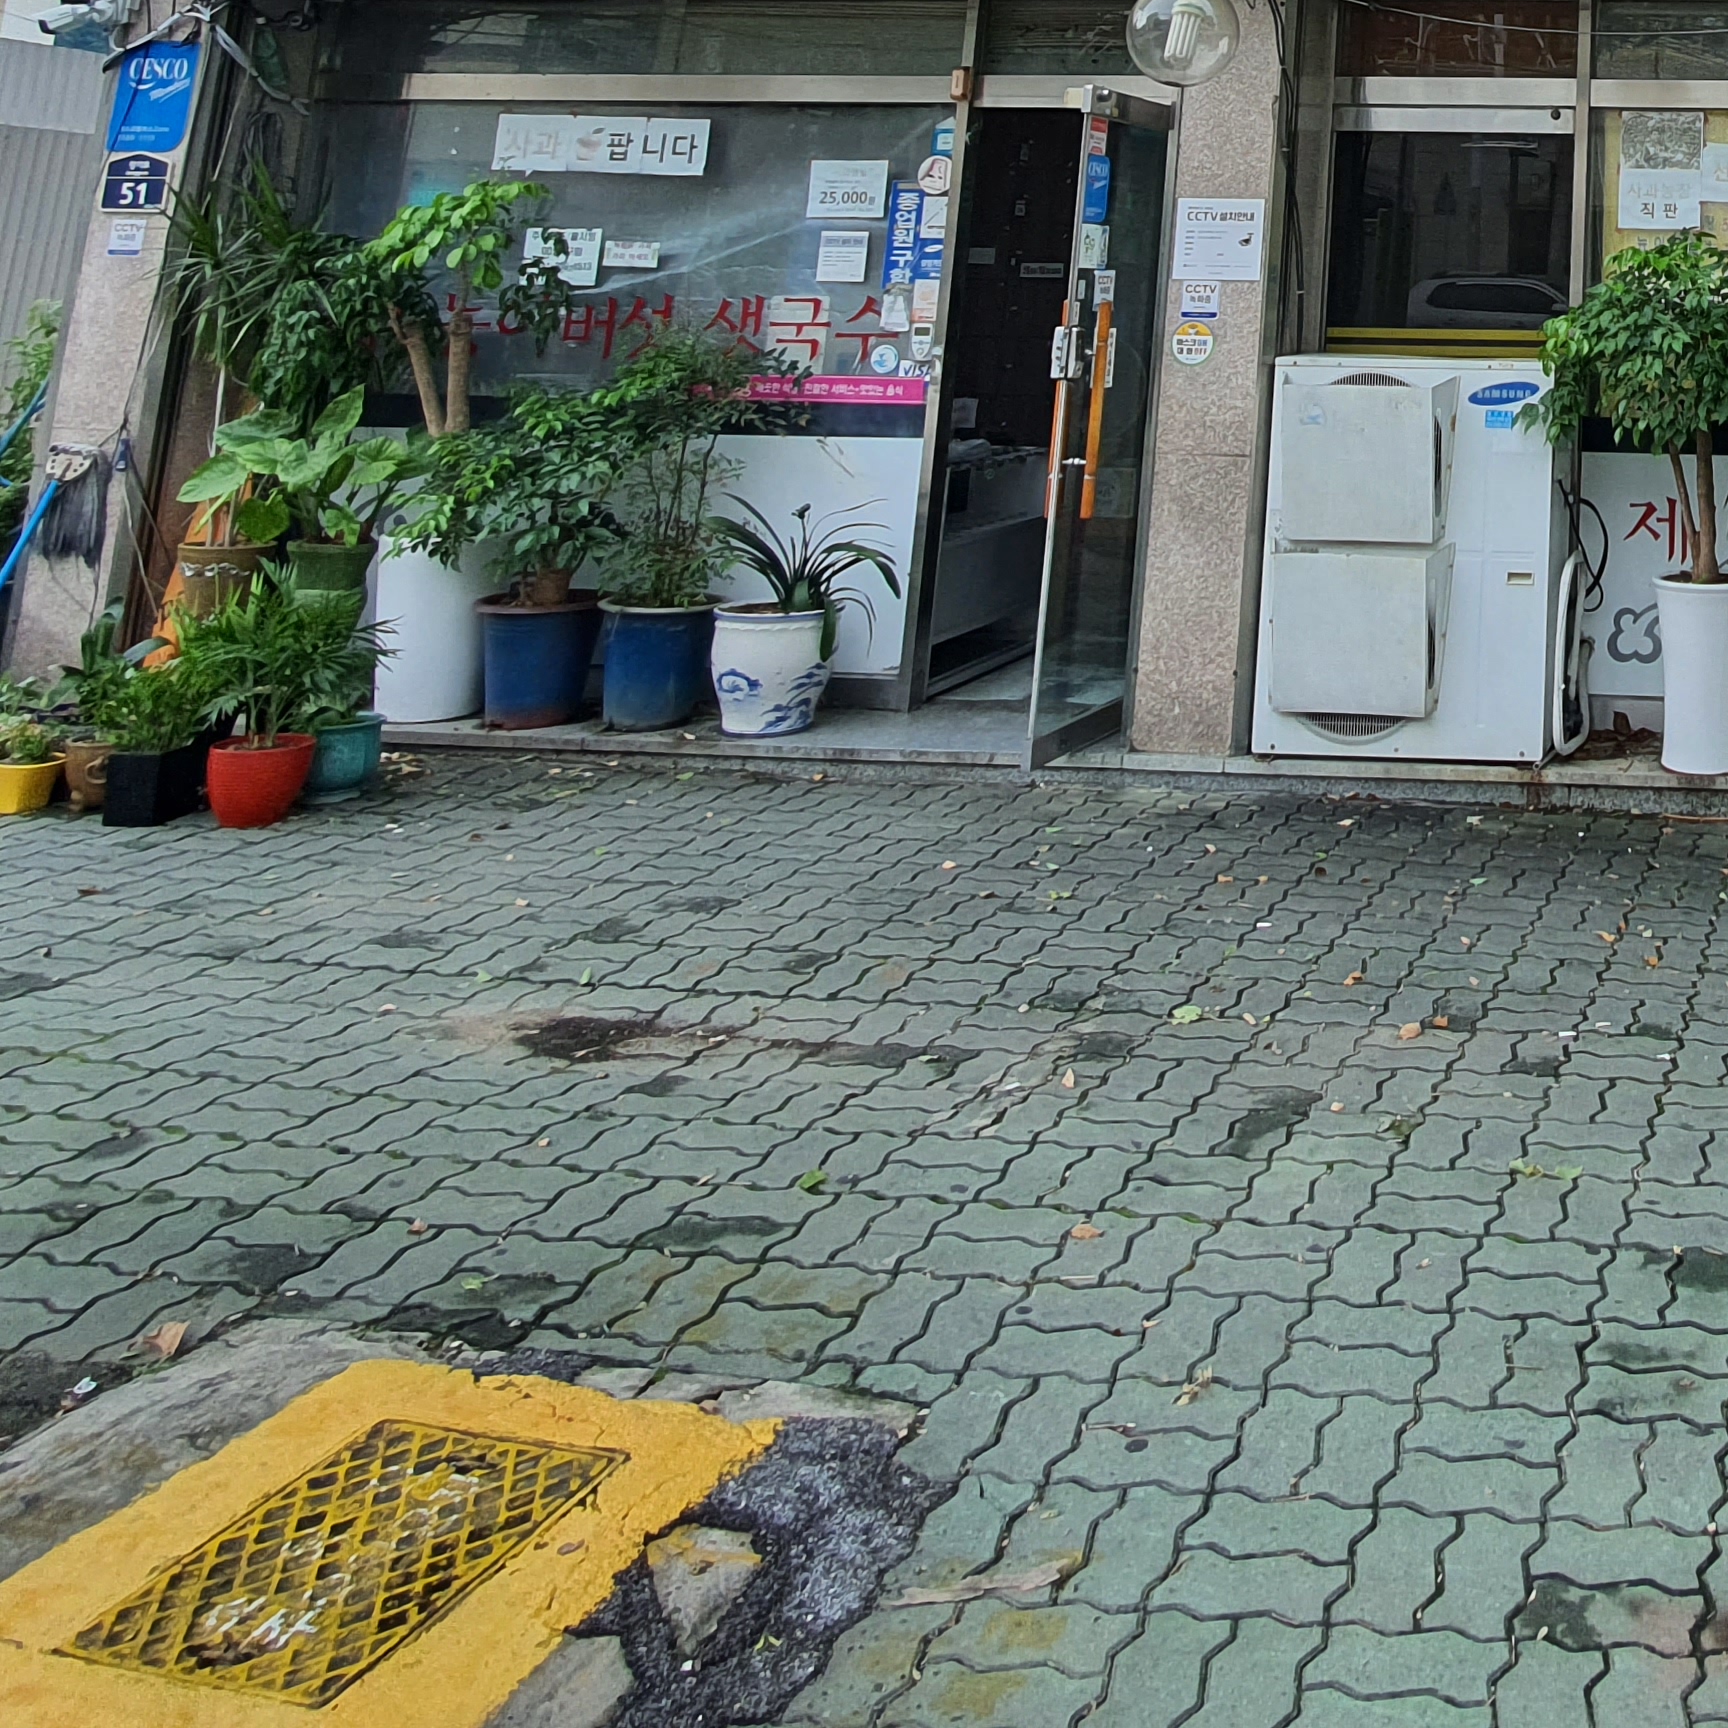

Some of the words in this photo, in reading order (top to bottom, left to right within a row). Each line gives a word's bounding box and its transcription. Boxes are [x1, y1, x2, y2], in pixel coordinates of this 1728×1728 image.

[129, 57, 189, 81] CESCO
[606, 132, 699, 164] 팝니다
[118, 182, 148, 205] 51
[1187, 211, 1218, 222] CCTV
[1219, 211, 1256, 223] 설치안내
[1185, 284, 1217, 294] CCTV
[1477, 389, 1532, 399] SAMSUNG
